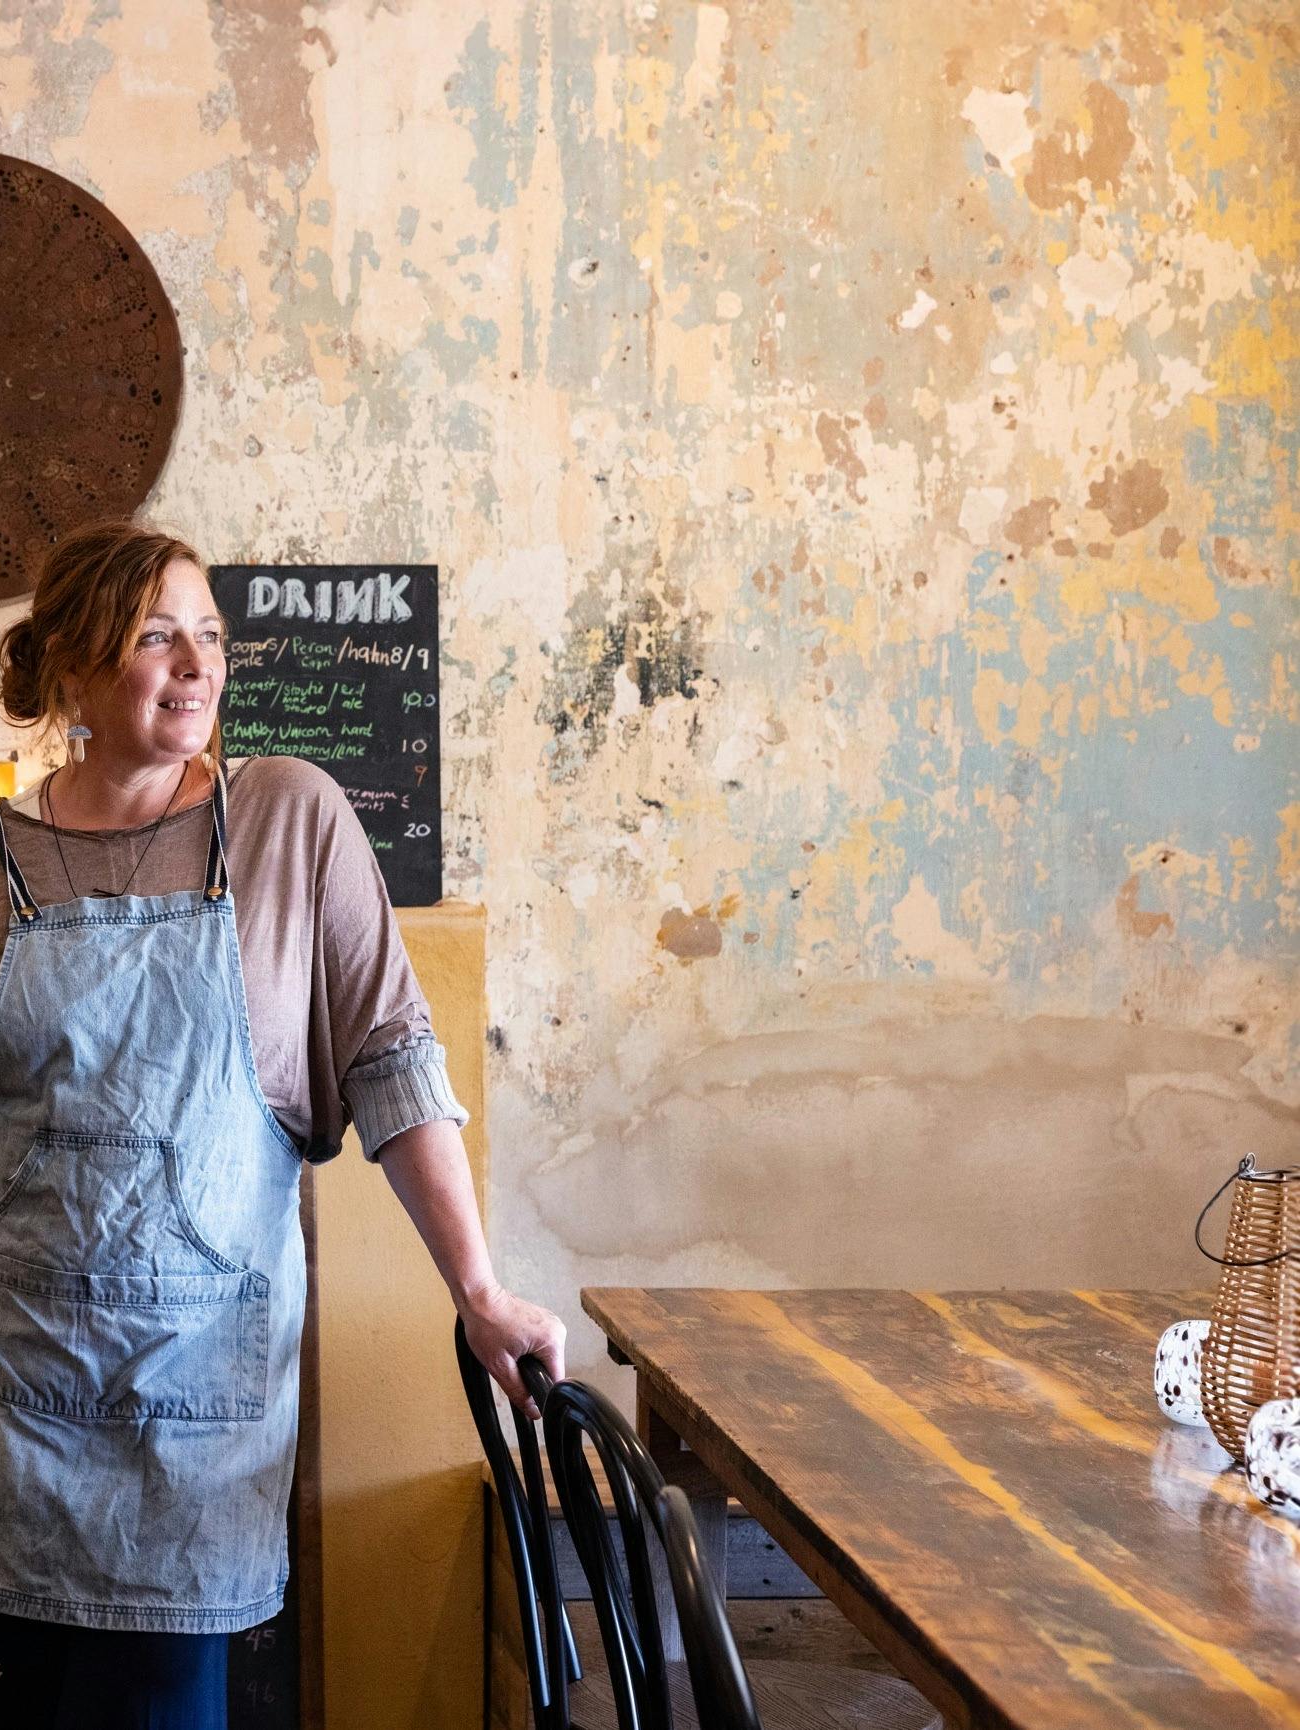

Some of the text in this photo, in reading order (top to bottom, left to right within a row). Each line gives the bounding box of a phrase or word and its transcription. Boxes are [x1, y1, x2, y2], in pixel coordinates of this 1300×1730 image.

[247, 573, 413, 625] DRINK
[402, 739, 428, 753] 10
[404, 823, 431, 838] 20
